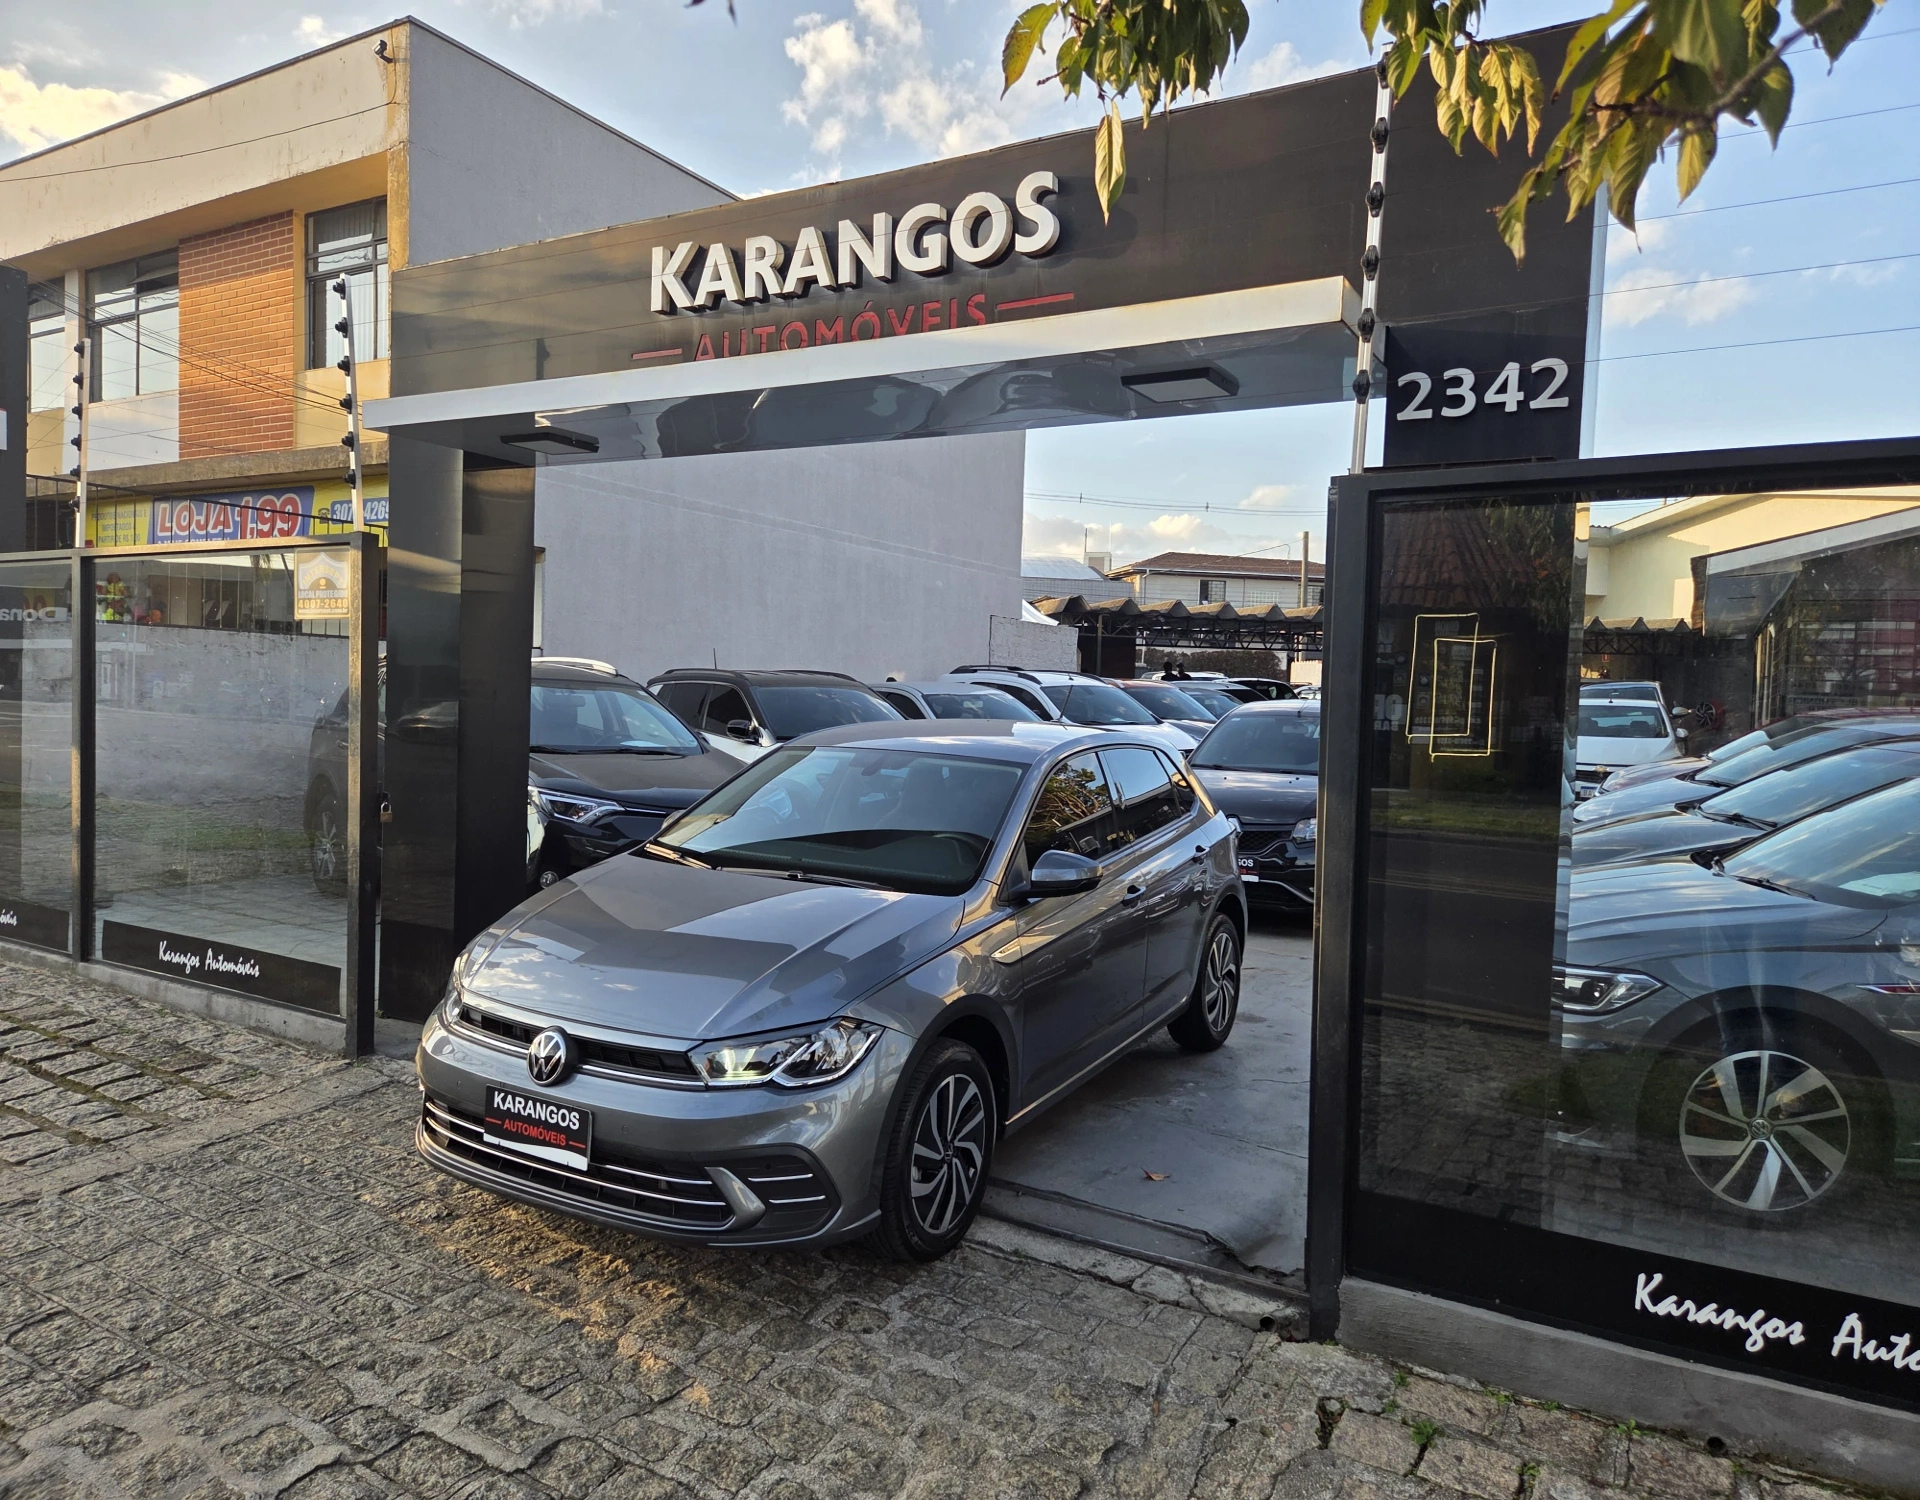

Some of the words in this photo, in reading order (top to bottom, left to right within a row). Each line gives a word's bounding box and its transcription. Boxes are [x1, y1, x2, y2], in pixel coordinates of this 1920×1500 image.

[651, 171, 1060, 314] KARANGOS
[694, 294, 987, 362] AUTOMÓVEIS
[1397, 358, 1569, 421] 2342
[157, 499, 233, 536] LOJA
[235, 493, 302, 539] 1,99
[298, 598, 348, 608] 4007-2640
[159, 940, 200, 974] Karangos
[205, 948, 260, 978] Automóveis
[493, 1090, 580, 1130] KARANGOS
[503, 1118, 567, 1146] AUTOMÓVEIS
[1635, 1273, 1806, 1352] Karangos
